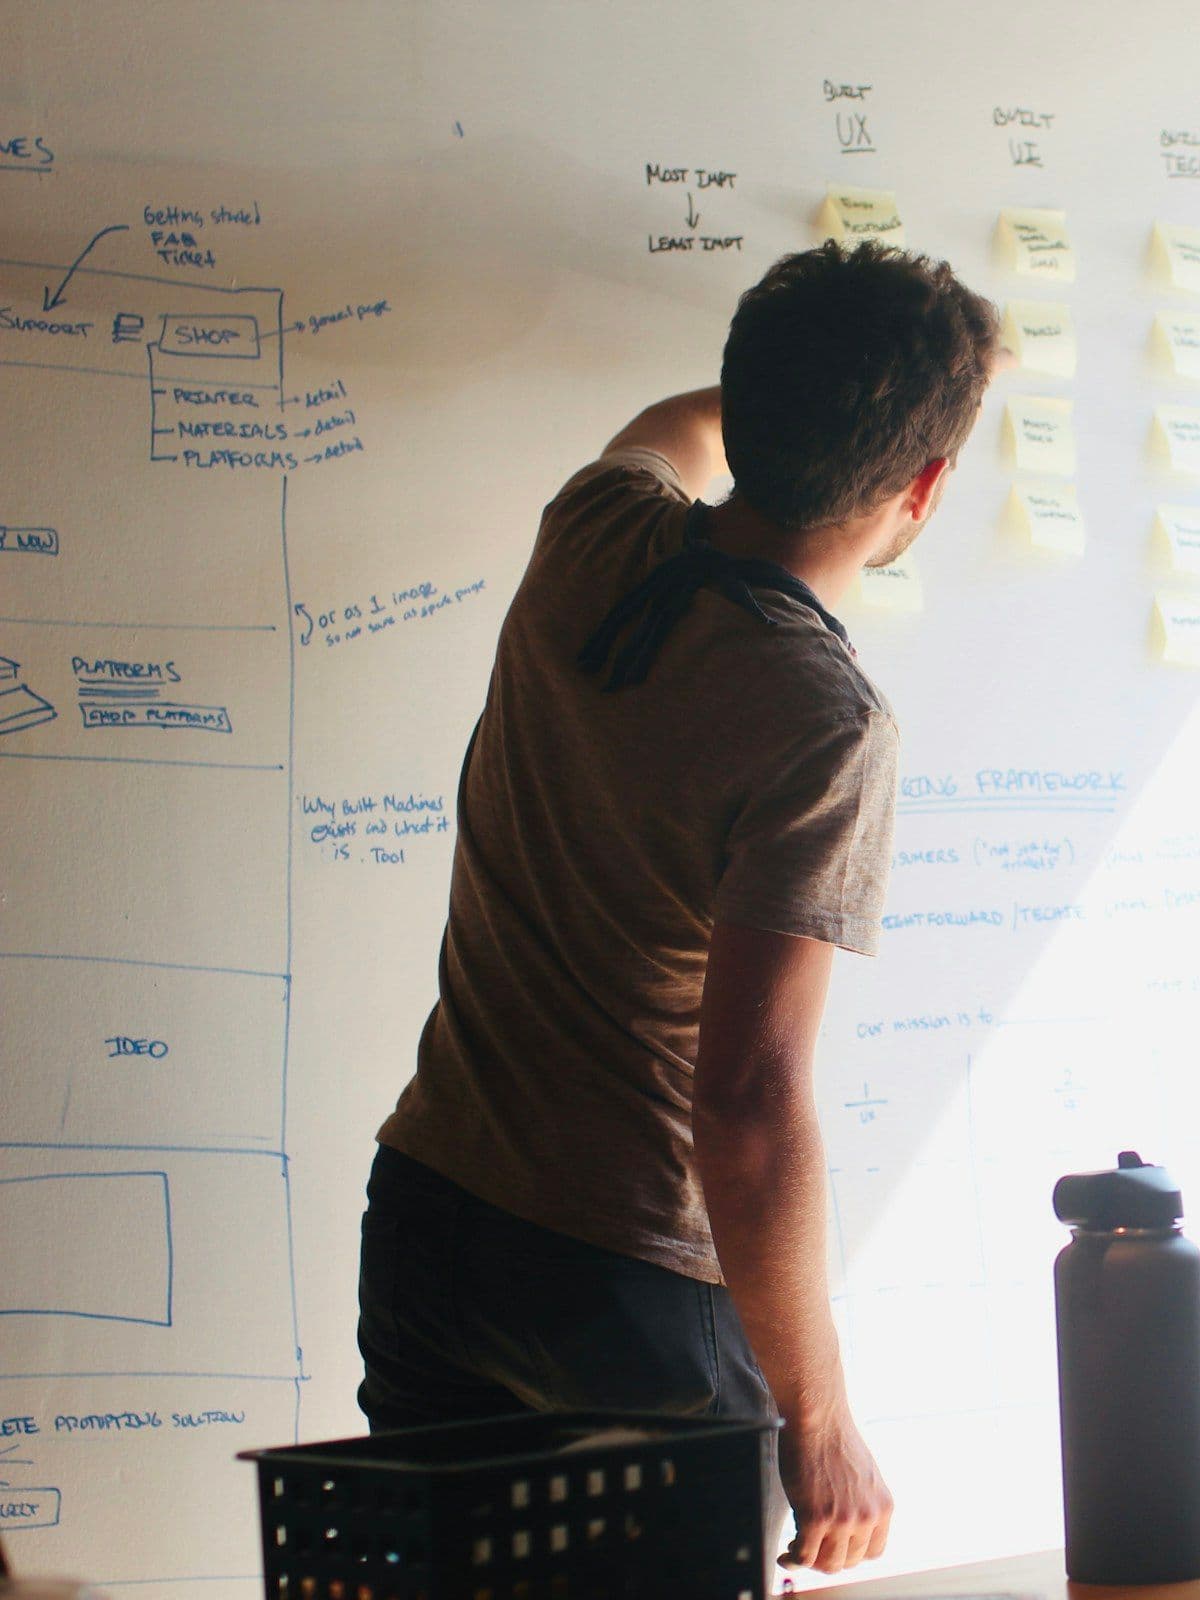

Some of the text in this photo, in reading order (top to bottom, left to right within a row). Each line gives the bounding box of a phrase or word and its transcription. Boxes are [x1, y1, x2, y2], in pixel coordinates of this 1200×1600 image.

[824, 79, 872, 101] BUILT
[993, 106, 1055, 128] BUILT
[836, 112, 872, 147] UX
[1008, 136, 1042, 167] UI
[648, 233, 695, 253] LEAST
[174, 325, 241, 345] SHOP
[173, 388, 259, 408] PRINTER
[178, 421, 289, 441] MATERIALS
[182, 449, 299, 470] PLATFORMS
[318, 610, 336, 628] or
[71, 656, 181, 682] PLATFORMS
[976, 769, 1126, 792] FRAMEWORK
